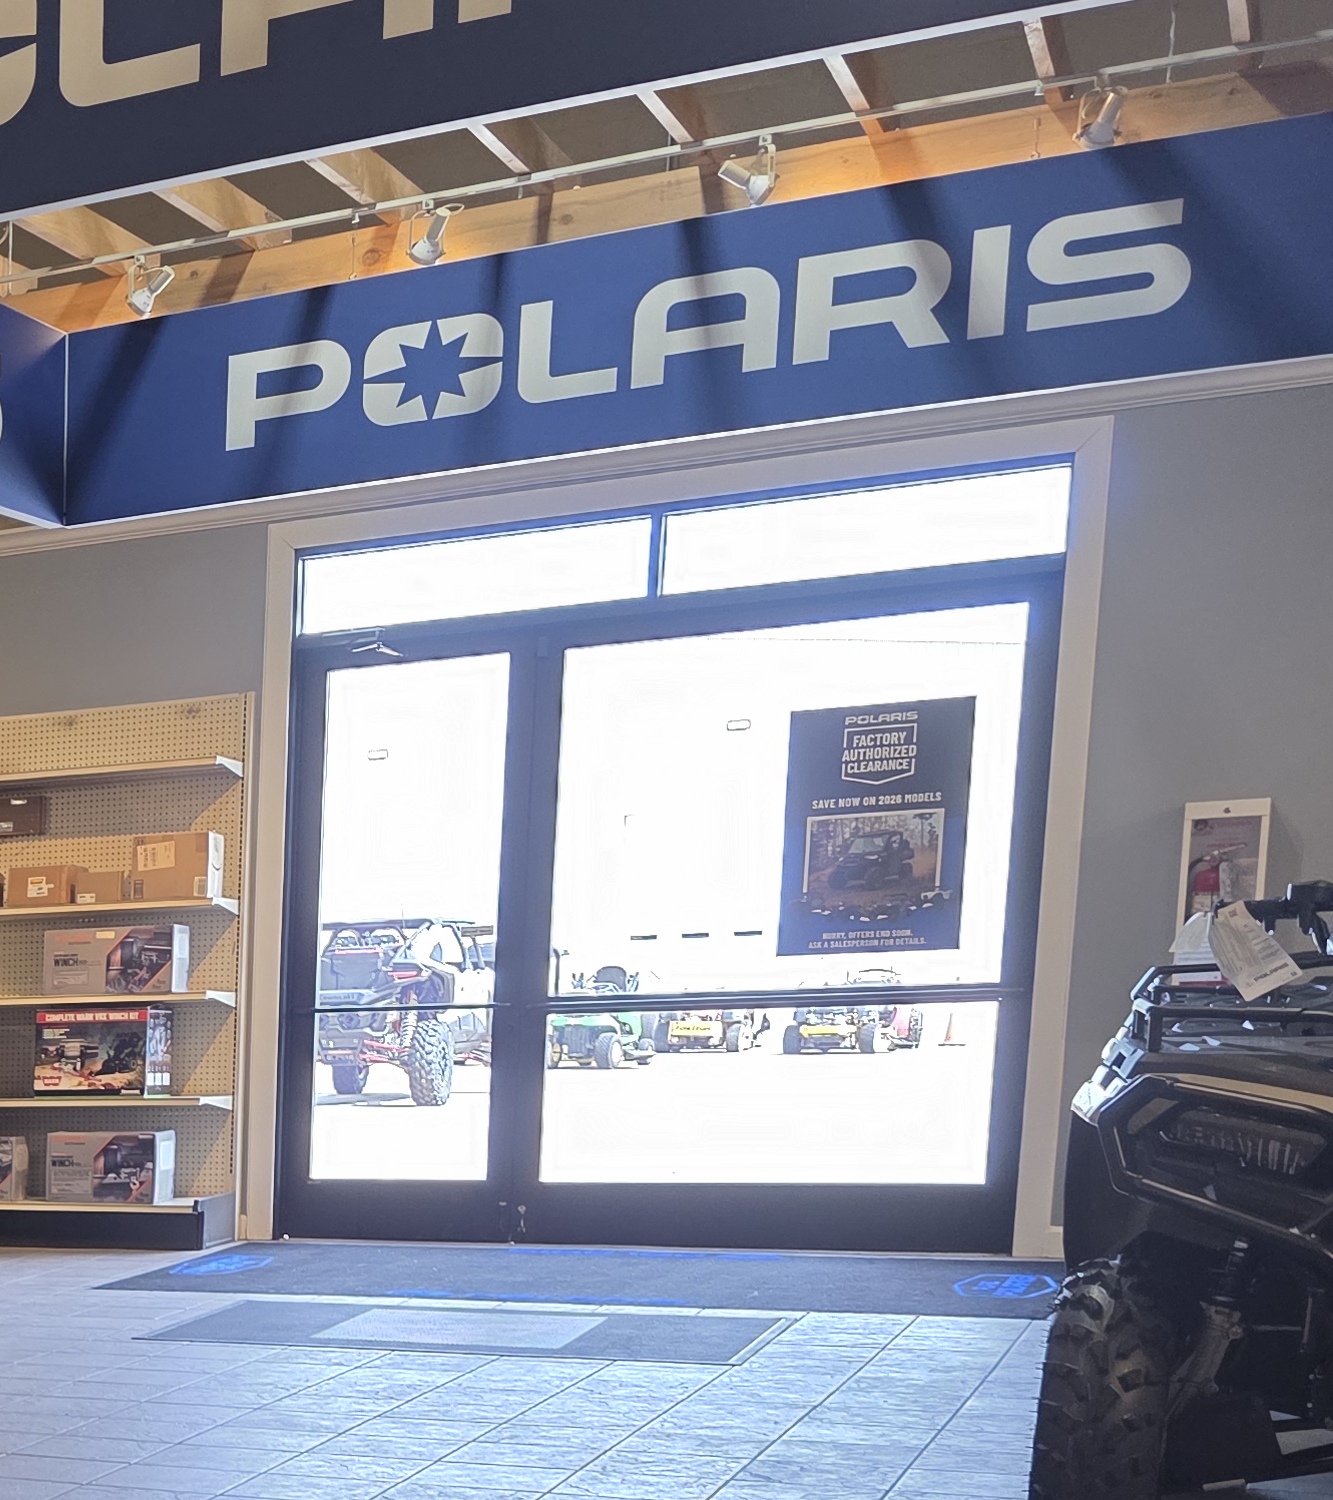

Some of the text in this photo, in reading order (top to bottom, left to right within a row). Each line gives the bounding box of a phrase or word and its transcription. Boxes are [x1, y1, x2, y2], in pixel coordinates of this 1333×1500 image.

[225, 198, 1192, 451] POLARIS
[845, 711, 918, 725] POLARIS
[853, 731, 907, 748] FACTORY
[842, 745, 917, 762] AUTHORIZED
[847, 758, 910, 774] CLEARANCE
[812, 799, 836, 809] SAVE
[838, 797, 860, 808] NOW
[863, 796, 876, 806] ON
[904, 792, 942, 803] MODELS
[808, 941, 822, 949] ASK
[830, 939, 878, 948] SALESPERSON
